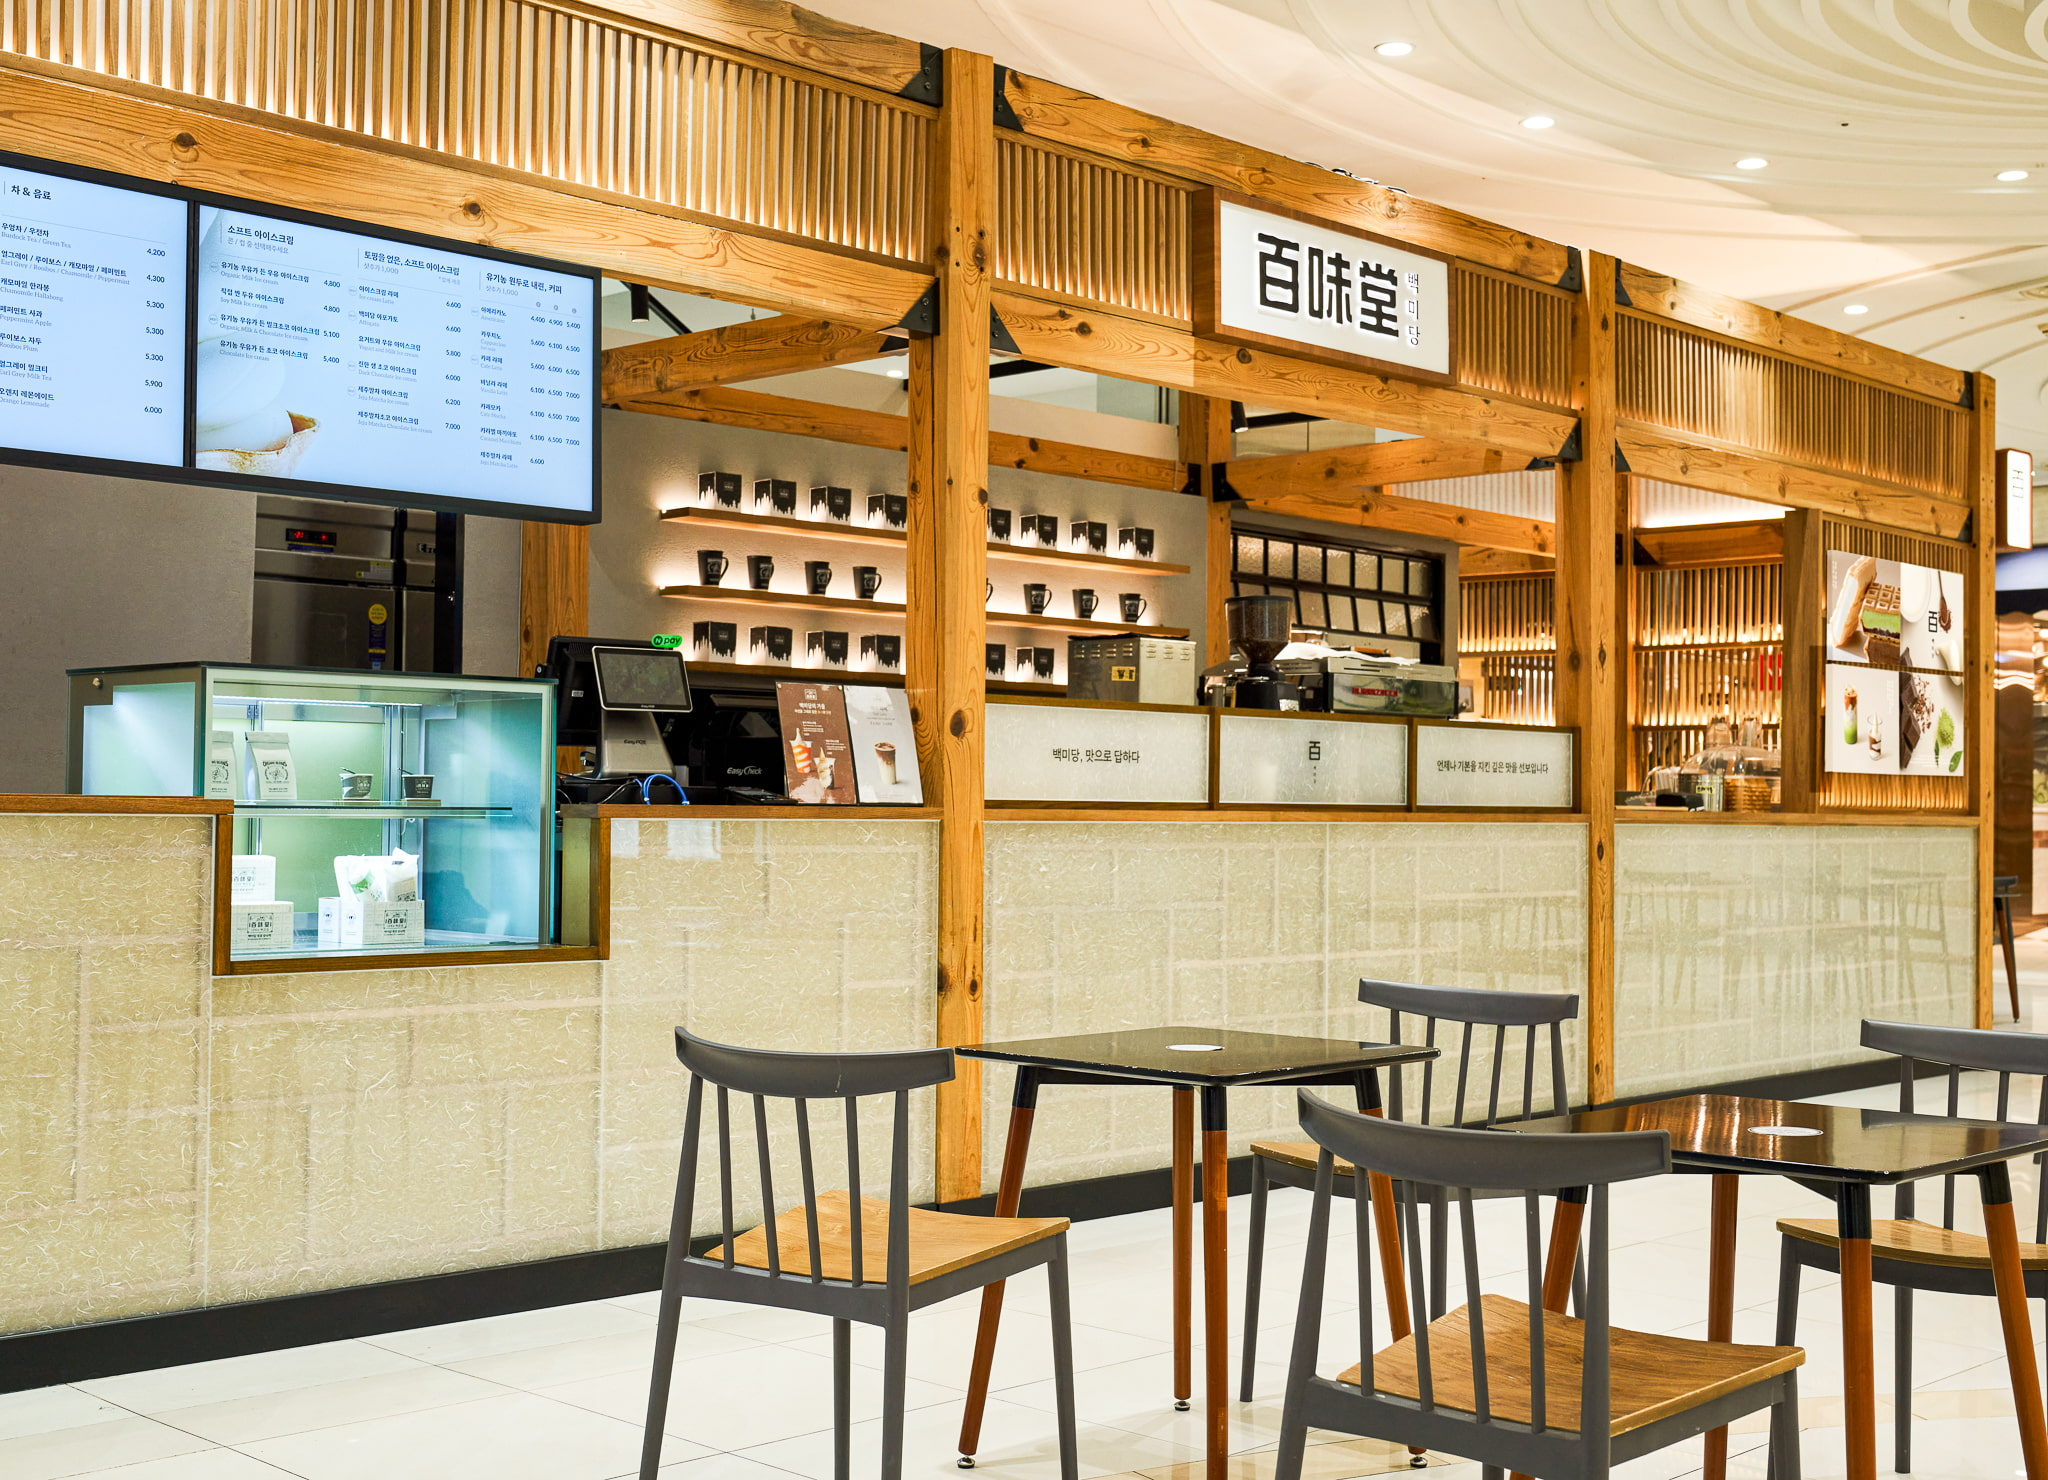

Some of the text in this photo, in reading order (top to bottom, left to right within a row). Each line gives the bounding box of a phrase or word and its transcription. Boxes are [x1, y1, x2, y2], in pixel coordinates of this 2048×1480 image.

[11, 185, 51, 200] 차 & 음료
[29, 228, 49, 237] 우전차
[228, 225, 294, 245] 소프트 아이스크림
[364, 251, 385, 262] 토핑을
[404, 258, 425, 269] 소프트
[426, 262, 460, 276] 아이스크림
[280, 272, 309, 283] 아이스크림
[486, 273, 562, 294] 유기농 원두로 내린, 커피
[359, 285, 386, 297] 아이스크림
[1258, 233, 1399, 337] 百味堂
[255, 293, 285, 305] 아이스크림
[28, 309, 43, 318] 사과
[1408, 273, 1420, 346] 백미당
[291, 325, 320, 336] 아이스크림
[394, 341, 421, 351] 아이스크림
[280, 349, 308, 360] 아이스크림
[28, 364, 48, 374] 밀크티
[390, 365, 417, 375] 아이스크림
[381, 389, 408, 399] 아이스크림
[392, 415, 419, 425] 아이스크림
[1928, 610, 1938, 633] 百
[663, 637, 680, 645] pay
[1053, 748, 1140, 764] 백미당, 맛으로 답하다
[1309, 741, 1320, 760] 百
[1437, 760, 1548, 774] 언제나 기본을 지킨 깊은 맛을 선보입니다
